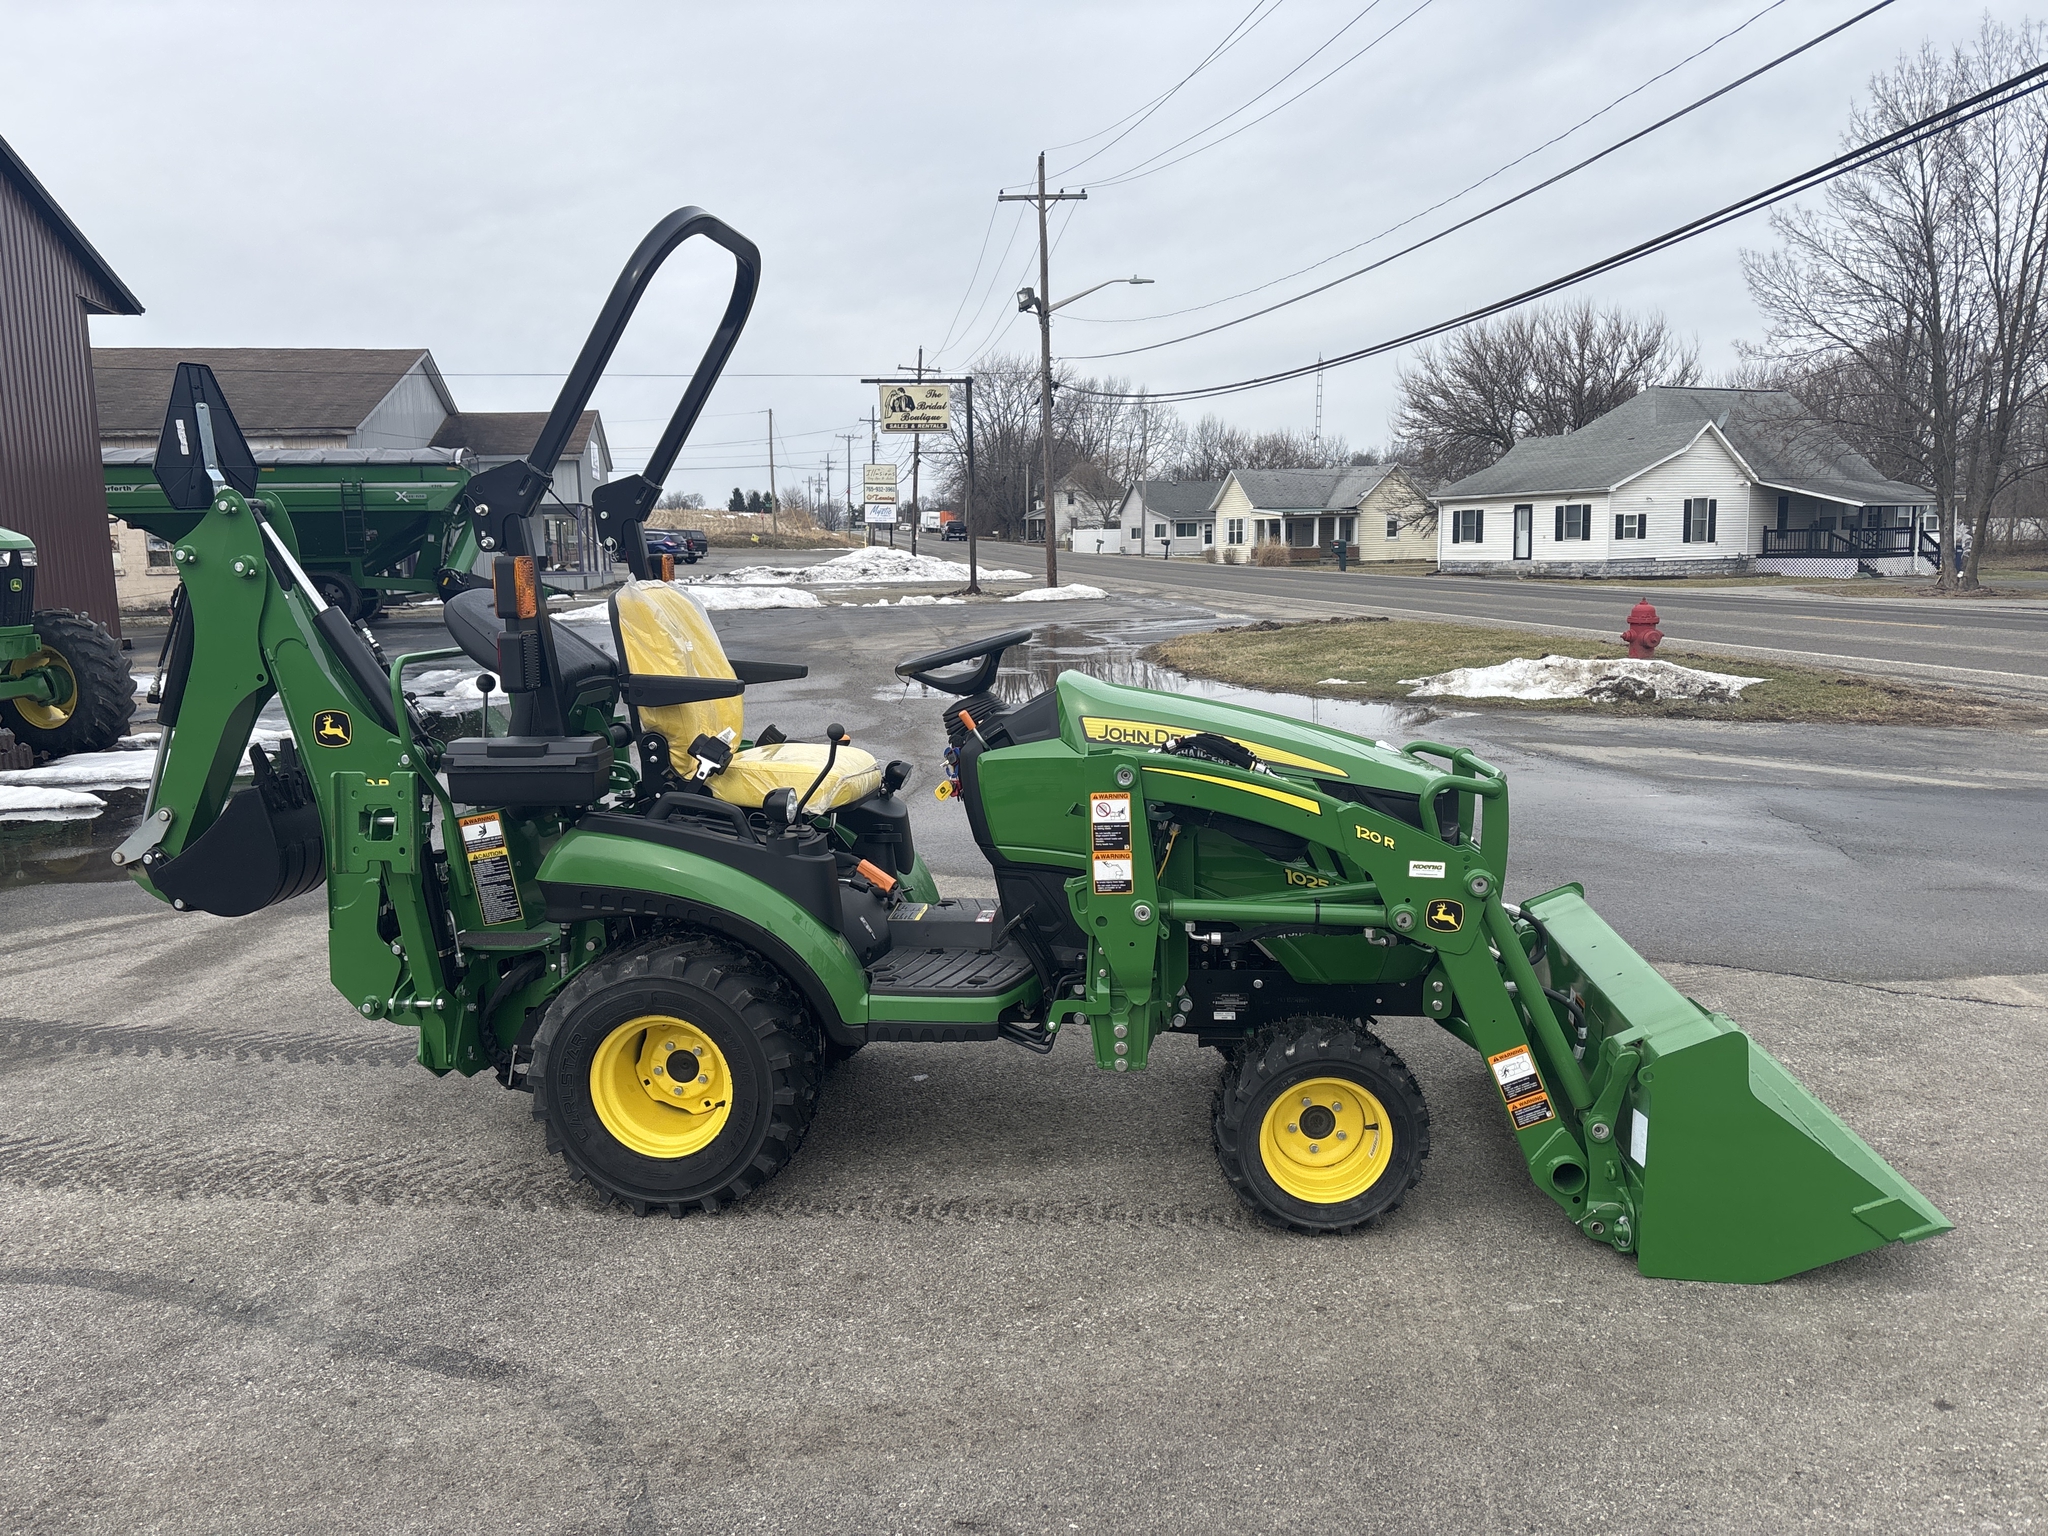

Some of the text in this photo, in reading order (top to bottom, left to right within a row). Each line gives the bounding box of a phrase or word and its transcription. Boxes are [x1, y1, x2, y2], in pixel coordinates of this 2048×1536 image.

[925, 388, 943, 399] The
[916, 401, 947, 410] Bridal
[900, 412, 943, 423] Boutique
[869, 504, 892, 517] Mystic
[1097, 724, 1150, 743] JOHN
[469, 815, 496, 825] WARNING
[1355, 824, 1396, 851] 120 R
[478, 850, 503, 860] CAUTION
[1498, 1047, 1524, 1061] WARNING
[1518, 1094, 1544, 1108] WARNING
